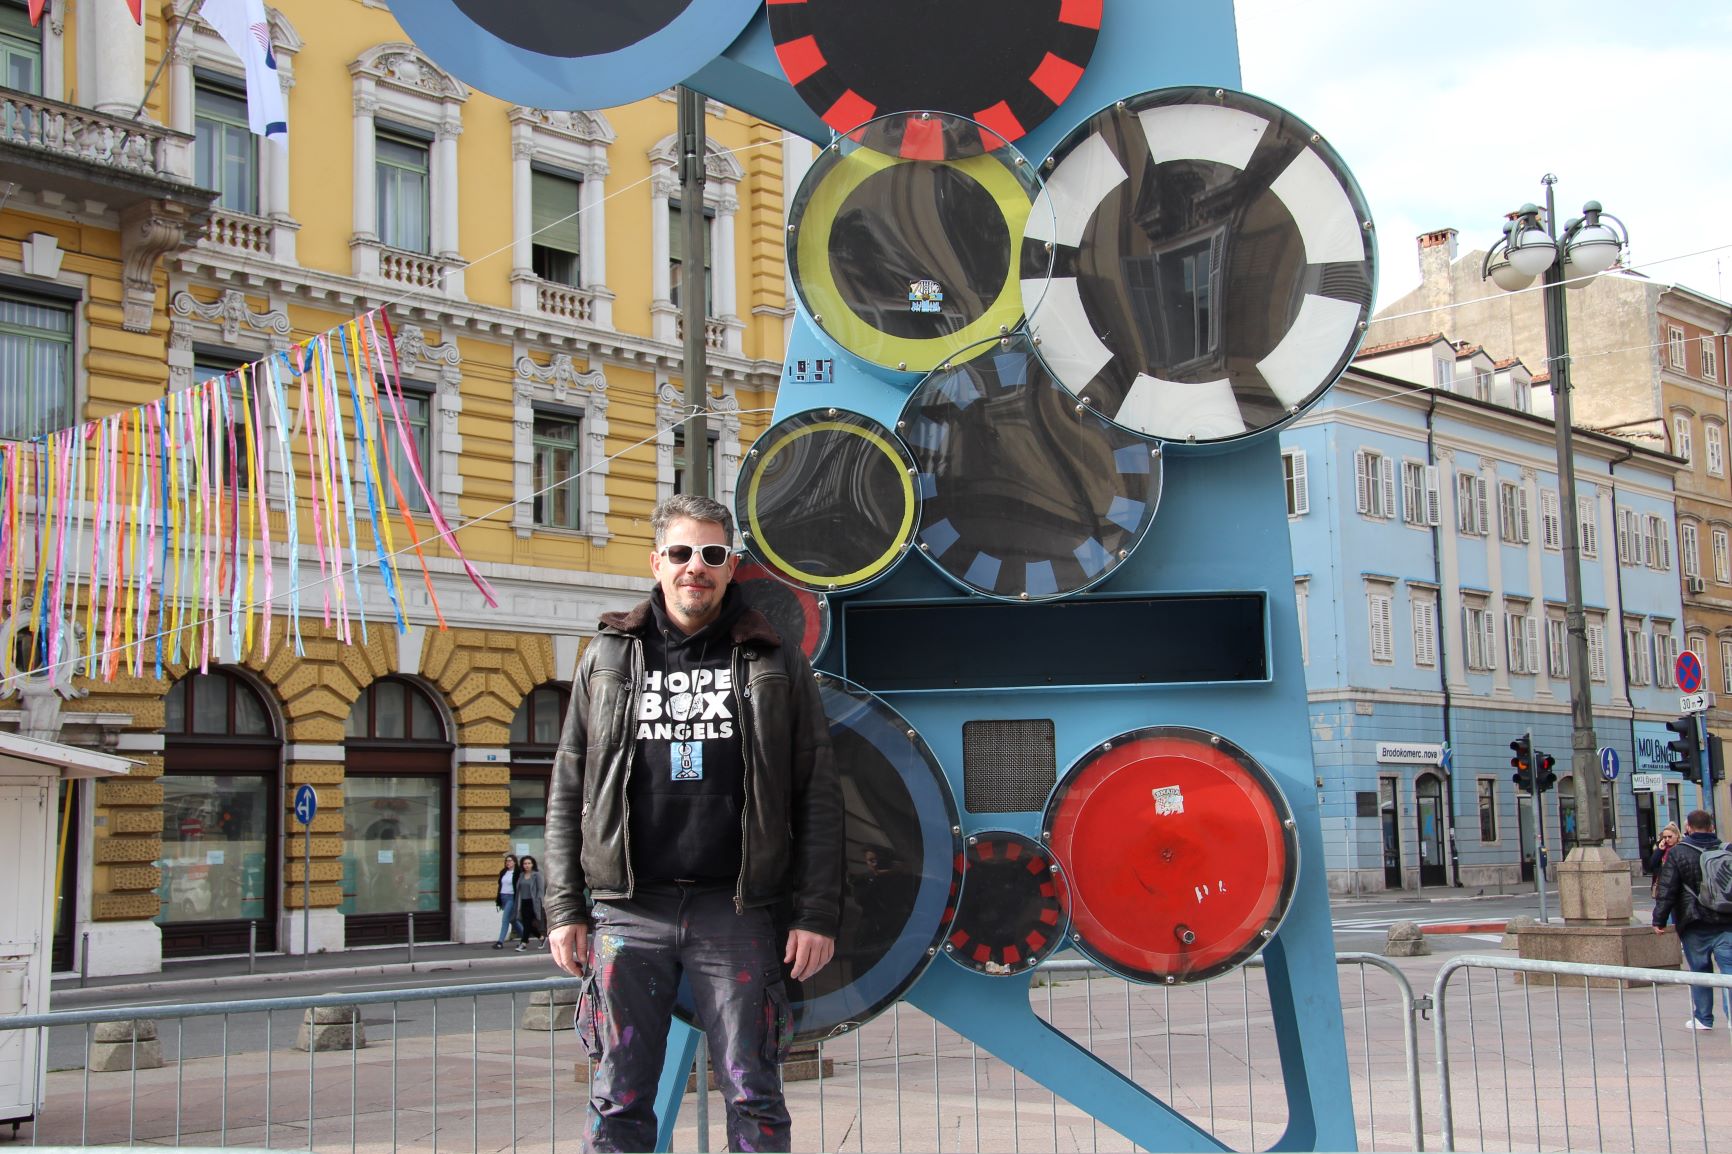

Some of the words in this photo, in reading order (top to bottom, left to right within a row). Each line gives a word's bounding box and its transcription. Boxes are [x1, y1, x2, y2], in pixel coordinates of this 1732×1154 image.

[643, 669, 732, 693] HOPE
[638, 691, 733, 721] BOX
[1682, 698, 1691, 710] 30
[636, 721, 734, 740] ANGELS
